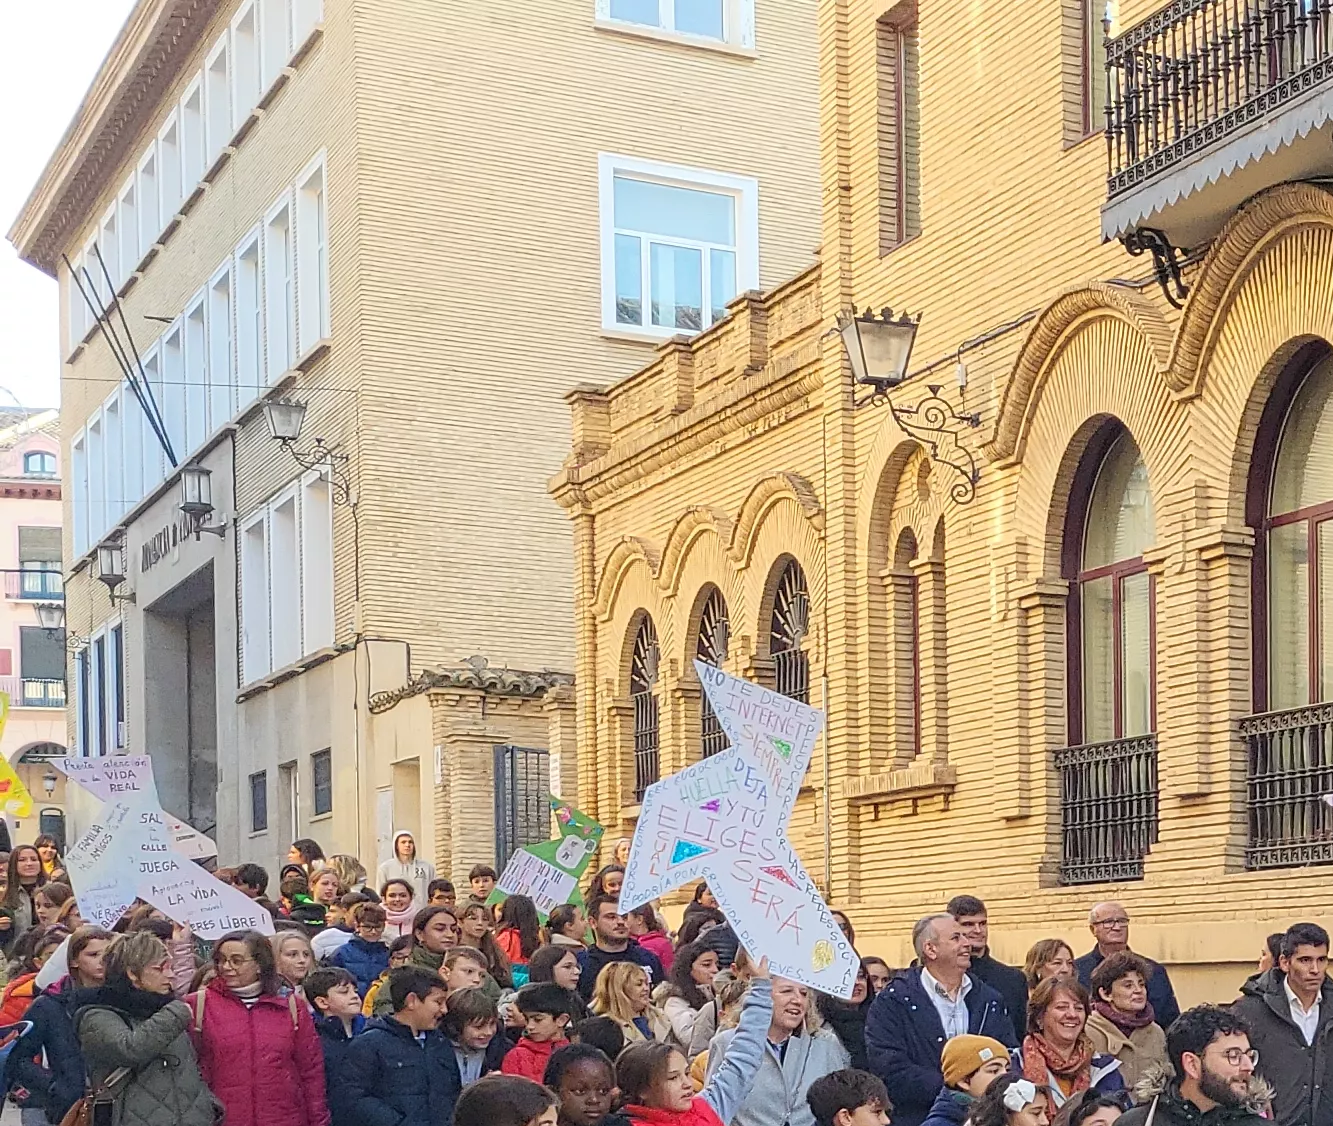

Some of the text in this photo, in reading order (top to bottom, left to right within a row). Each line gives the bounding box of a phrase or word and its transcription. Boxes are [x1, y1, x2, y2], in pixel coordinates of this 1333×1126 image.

[703, 666, 725, 687] NO
[730, 677, 754, 697] TE
[104, 769, 137, 780] VIDA
[734, 757, 770, 808] DEJA
[109, 782, 140, 793] REAL
[139, 812, 163, 825] SAL
[656, 804, 777, 862] ELIGES
[139, 859, 180, 873] JUEGA
[168, 886, 219, 907] LA VIDA
[730, 859, 806, 946] SERÁ
[219, 915, 258, 931] LIBRE
